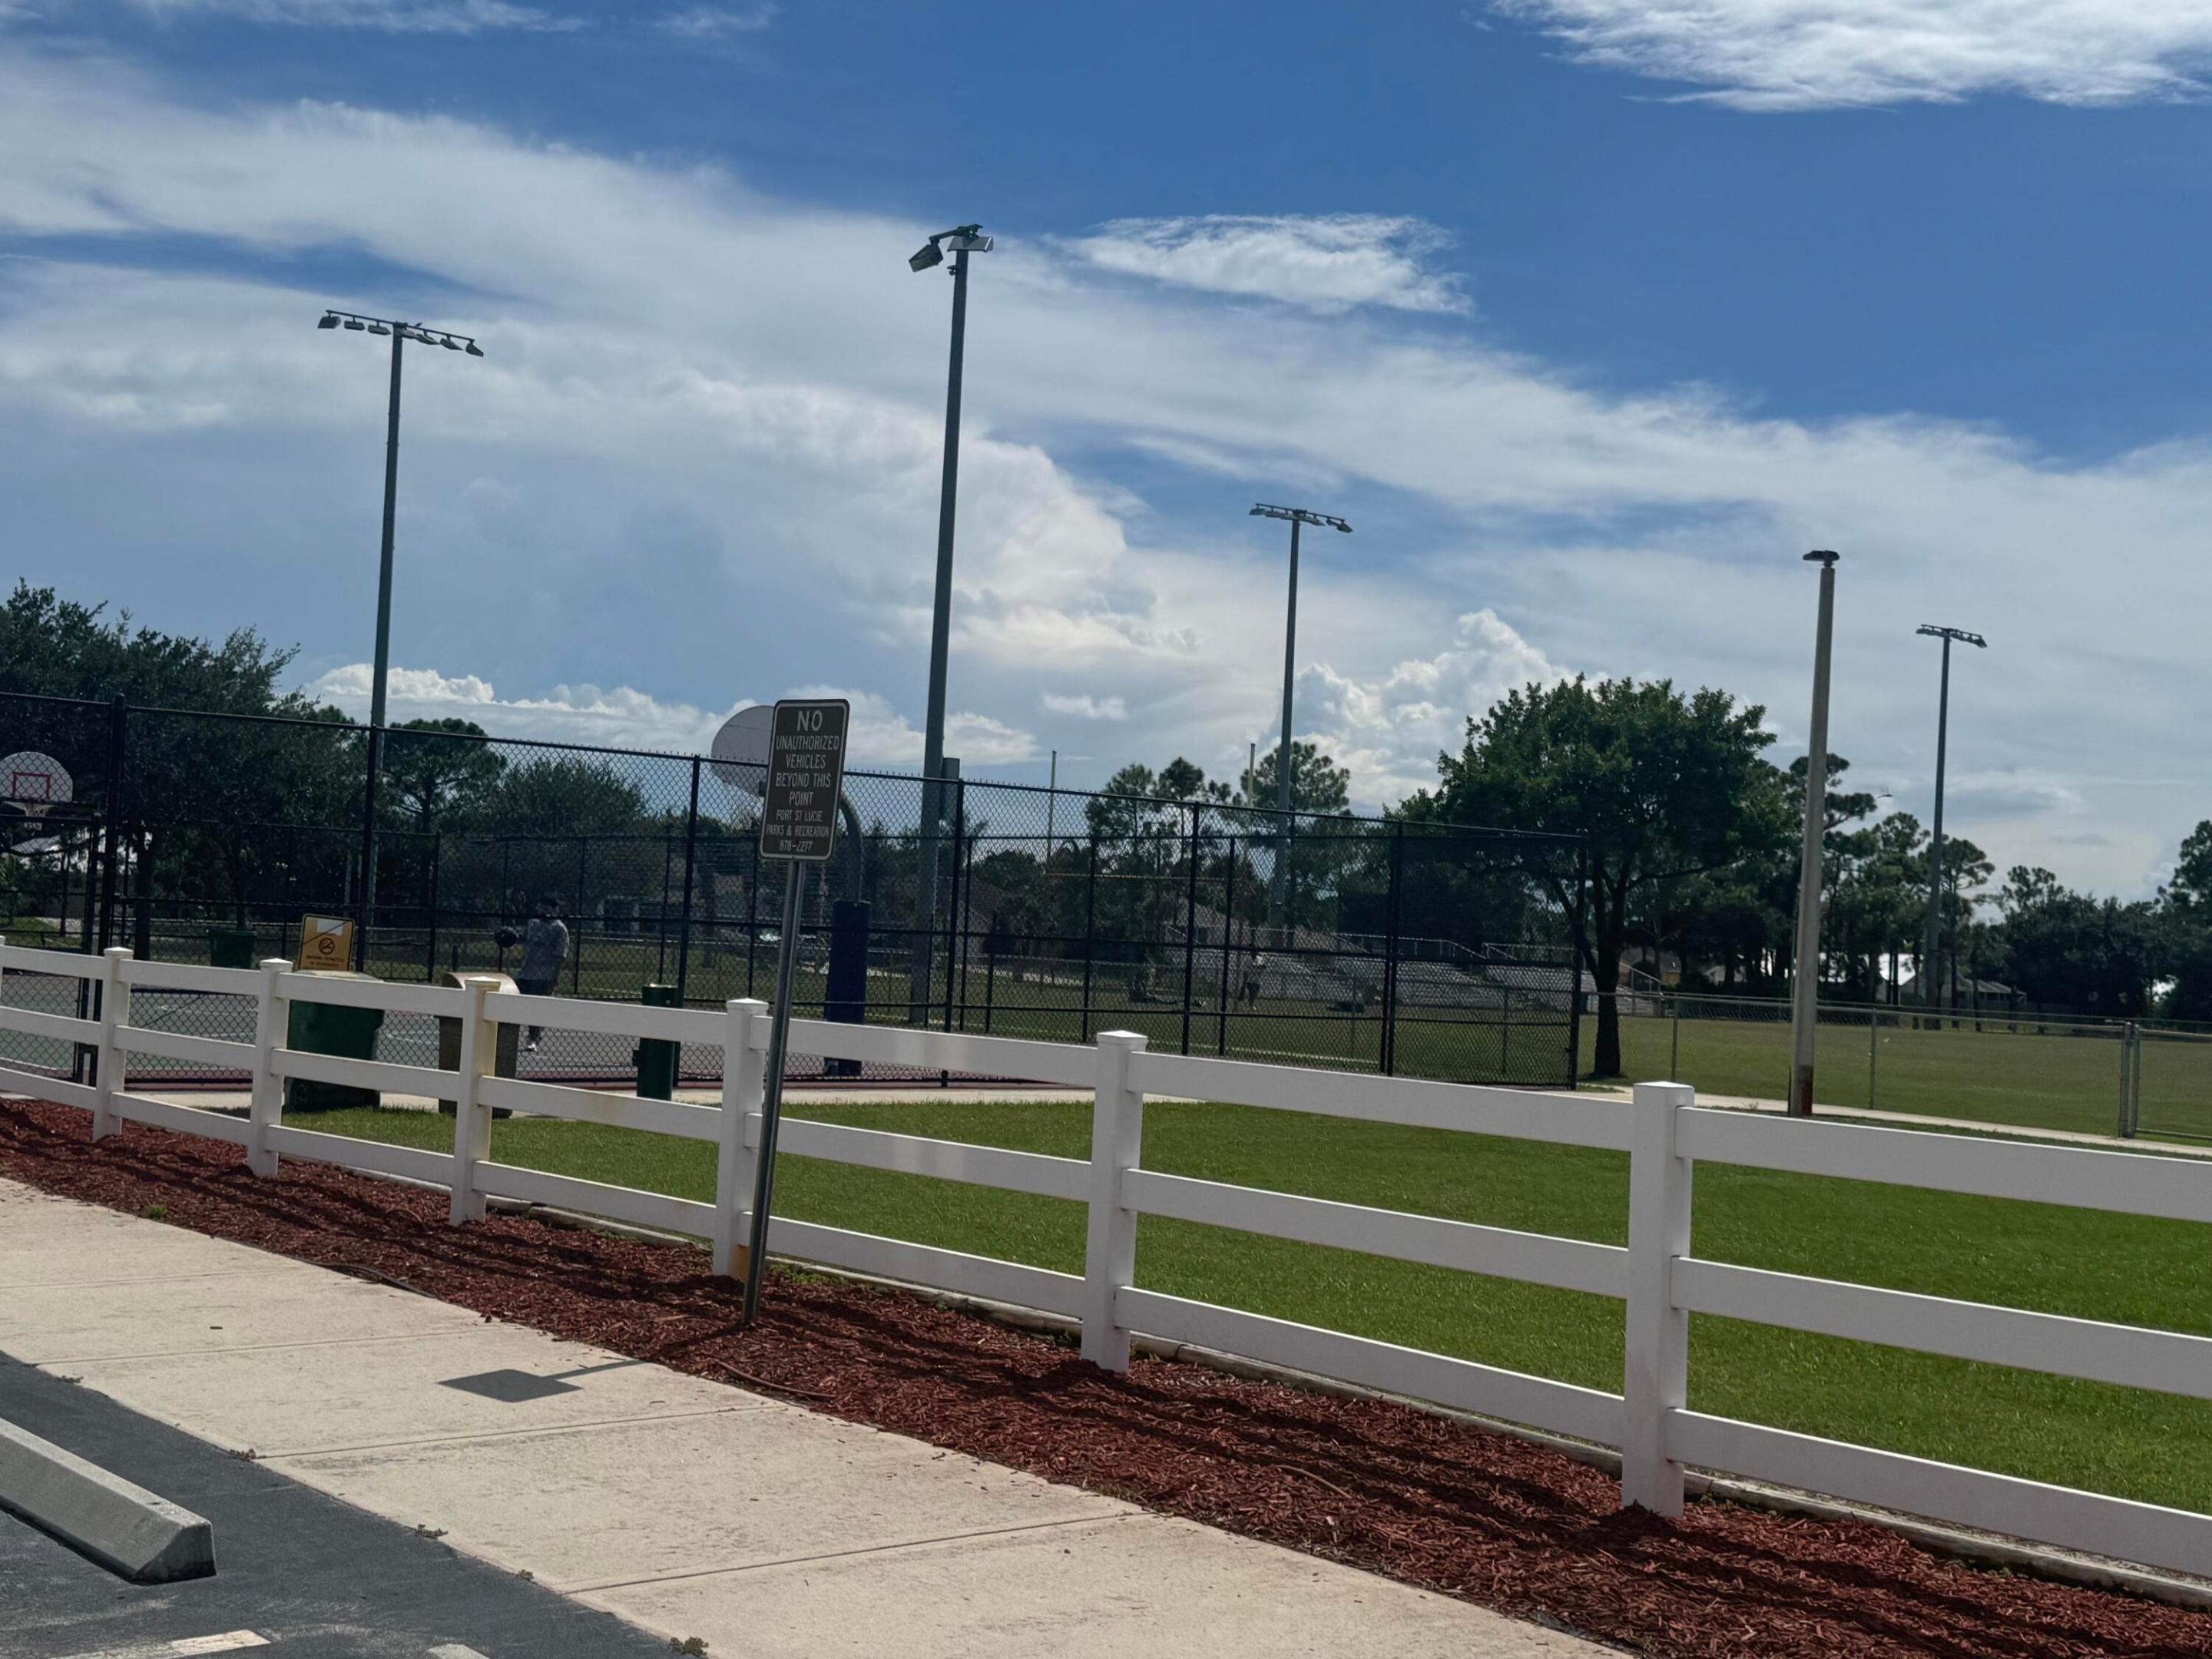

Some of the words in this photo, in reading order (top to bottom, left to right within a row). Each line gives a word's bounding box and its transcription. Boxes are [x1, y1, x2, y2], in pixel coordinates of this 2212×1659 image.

[796, 710, 823, 731] NO
[776, 735, 839, 750] UNAUTHORIZED
[786, 754, 826, 769] VEHICLES
[775, 773, 810, 787] BEYOND
[813, 773, 831, 788] THIS
[789, 792, 814, 806] POINT
[795, 810, 803, 822] ST
[804, 810, 823, 822] LUCIE
[766, 824, 784, 836] PARKS
[786, 825, 792, 836] &
[794, 825, 830, 837] RECREATION
[779, 839, 813, 852] 878-2277
